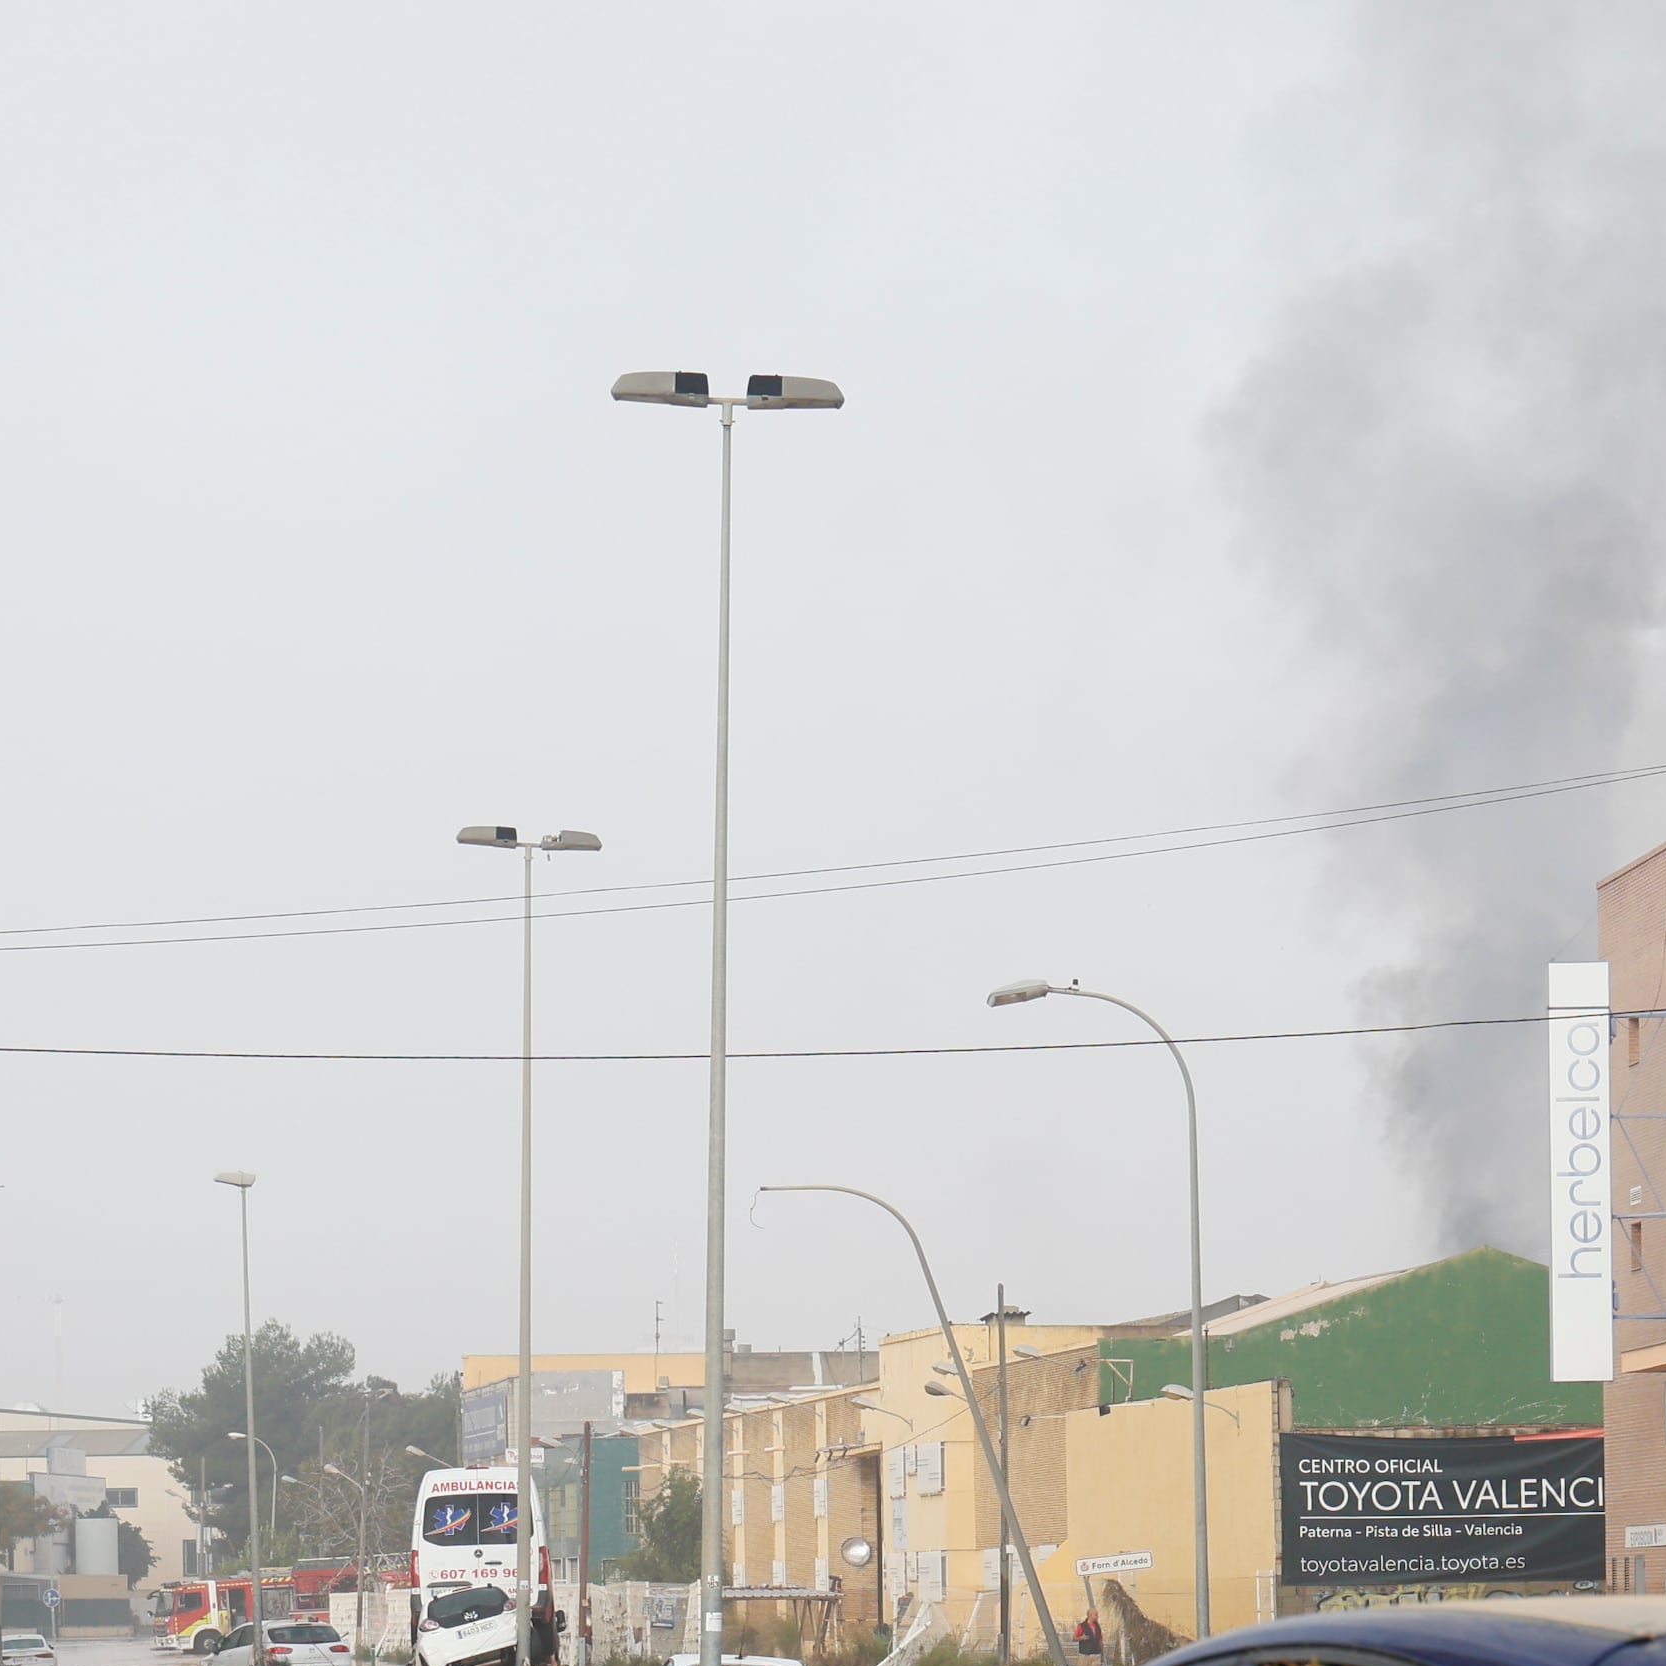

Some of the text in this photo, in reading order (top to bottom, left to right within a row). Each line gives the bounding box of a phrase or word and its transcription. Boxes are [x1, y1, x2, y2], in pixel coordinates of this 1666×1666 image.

[1556, 1022, 1602, 1278] herbelca
[1299, 1458, 1443, 1474] CENTRO OFICIAL
[1299, 1477, 1604, 1511] TOYOTA VALENCI
[1299, 1525, 1352, 1538] Paterna
[1365, 1525, 1399, 1538] Pista
[1402, 1524, 1419, 1537] de
[1423, 1523, 1452, 1537] Silla
[1464, 1523, 1523, 1537] Valencia
[1092, 1557, 1149, 1570] Forn d'Alcedo
[1300, 1554, 1526, 1576] toyotavalencia.toyota.es
[440, 1568, 517, 1579] 607 169 96
